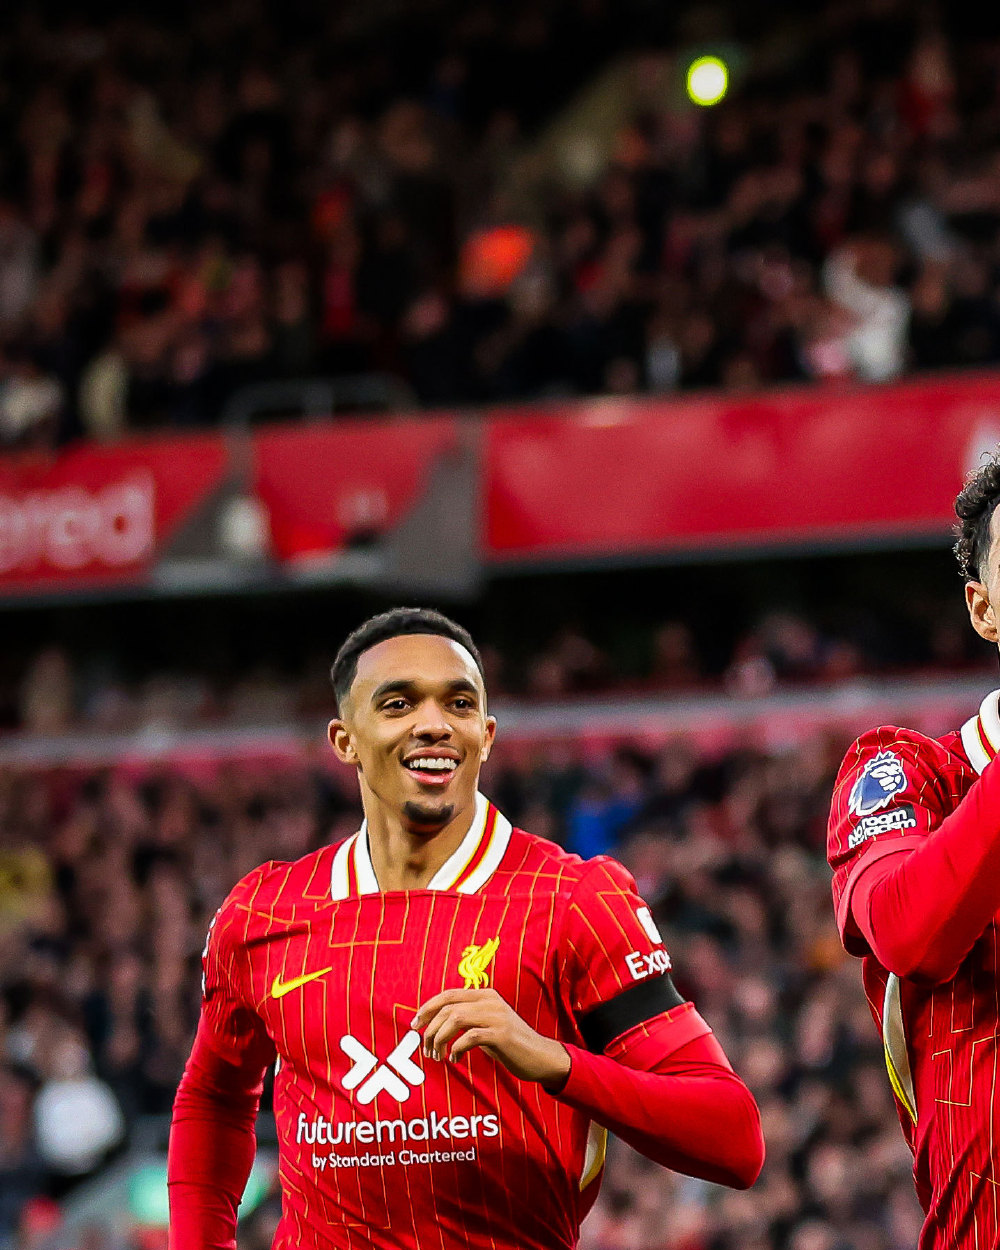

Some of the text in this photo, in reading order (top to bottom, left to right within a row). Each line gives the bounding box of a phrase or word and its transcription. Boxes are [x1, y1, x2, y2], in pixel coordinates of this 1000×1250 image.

[625, 950, 672, 980] Exp
[296, 1111, 500, 1145] futuremakers
[312, 1147, 476, 1172] by Standard Chartered
